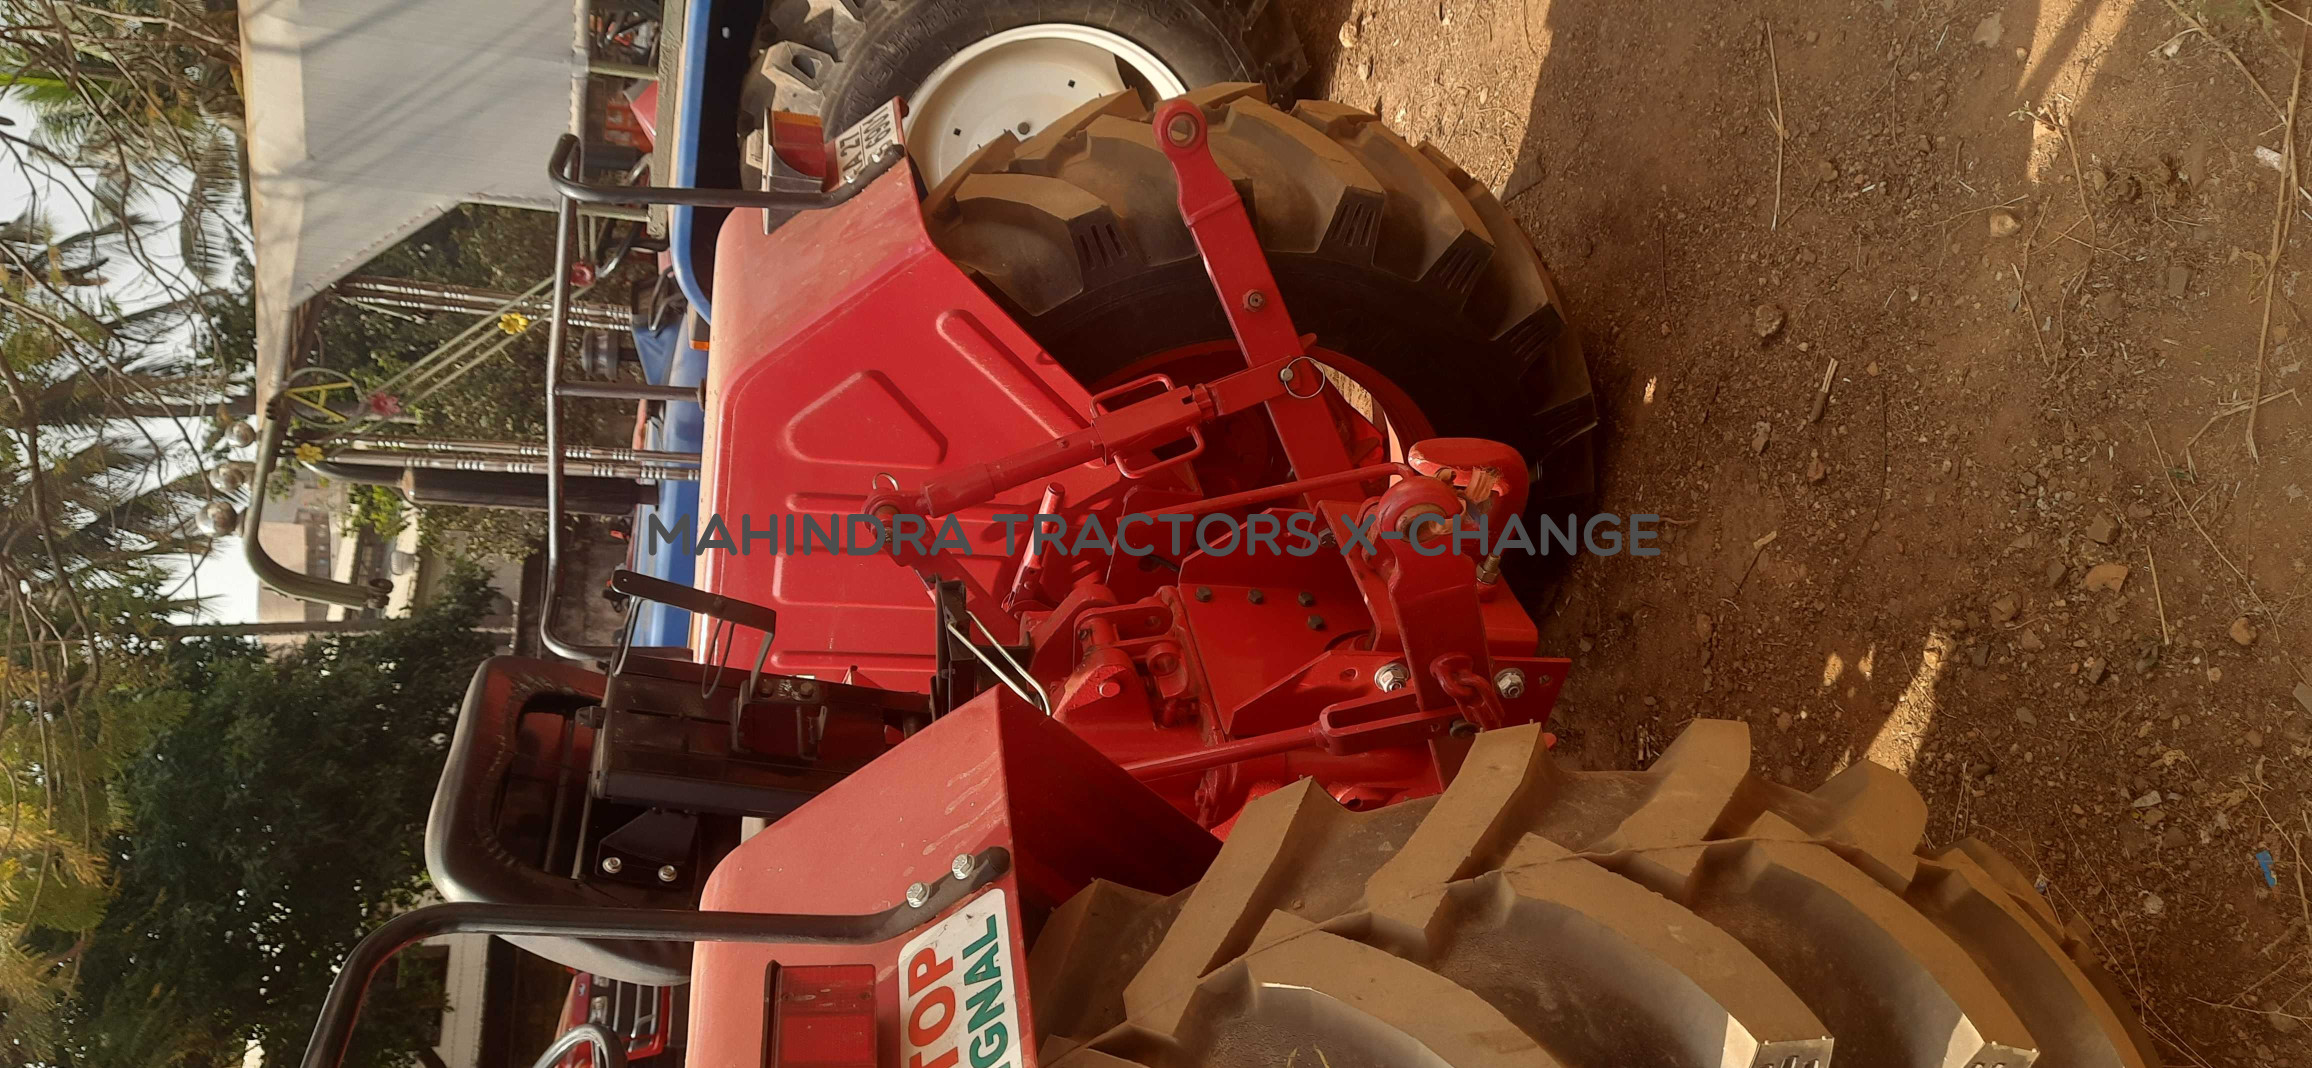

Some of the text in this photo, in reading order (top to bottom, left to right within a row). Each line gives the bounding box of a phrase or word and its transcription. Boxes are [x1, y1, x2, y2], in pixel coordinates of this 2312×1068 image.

[840, 131, 861, 157] 27
[862, 106, 891, 149] 6901
[962, 913, 1011, 1068] GNAL
